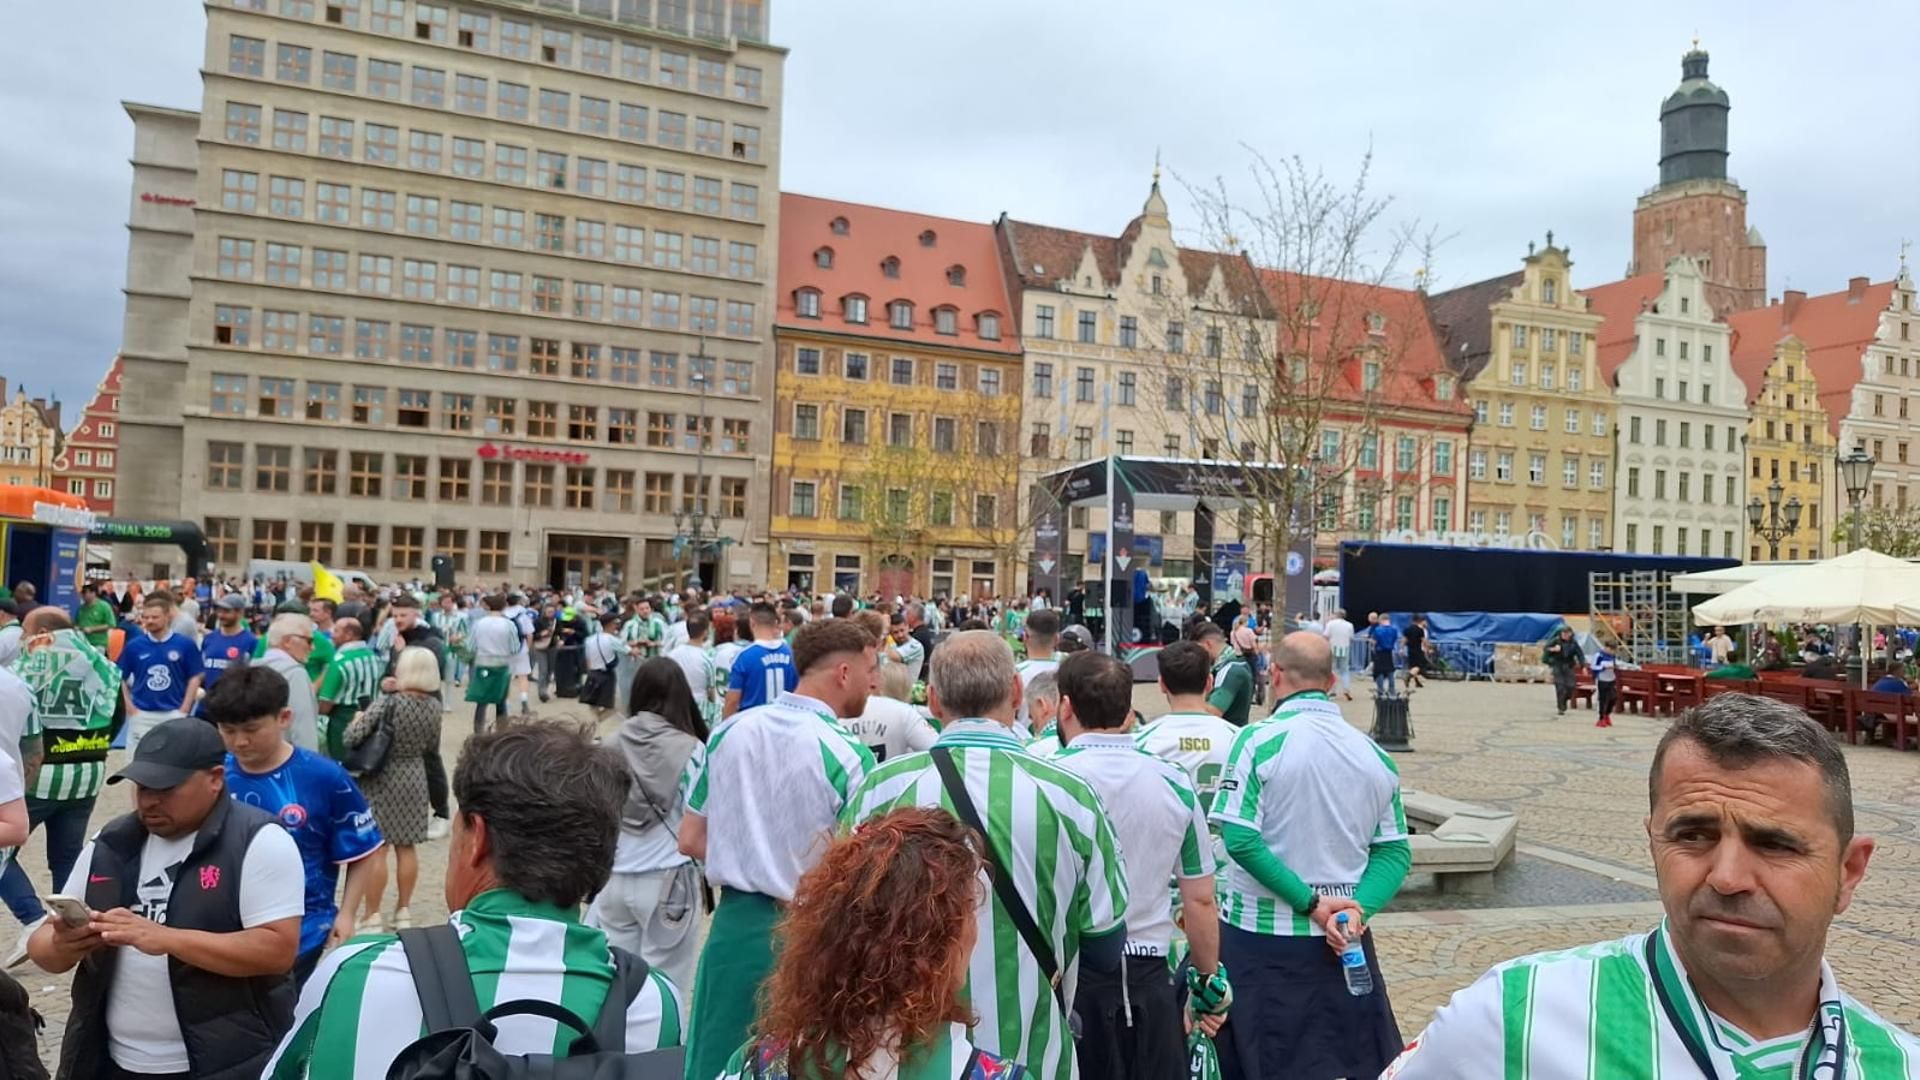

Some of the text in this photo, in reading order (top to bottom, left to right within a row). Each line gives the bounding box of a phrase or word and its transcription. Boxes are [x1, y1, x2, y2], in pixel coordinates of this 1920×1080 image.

[502, 444, 592, 464] Santander
[106, 522, 142, 537] FINAL
[143, 525, 172, 538] 2025
[147, 663, 171, 691] 3
[1179, 737, 1211, 752] ISCO
